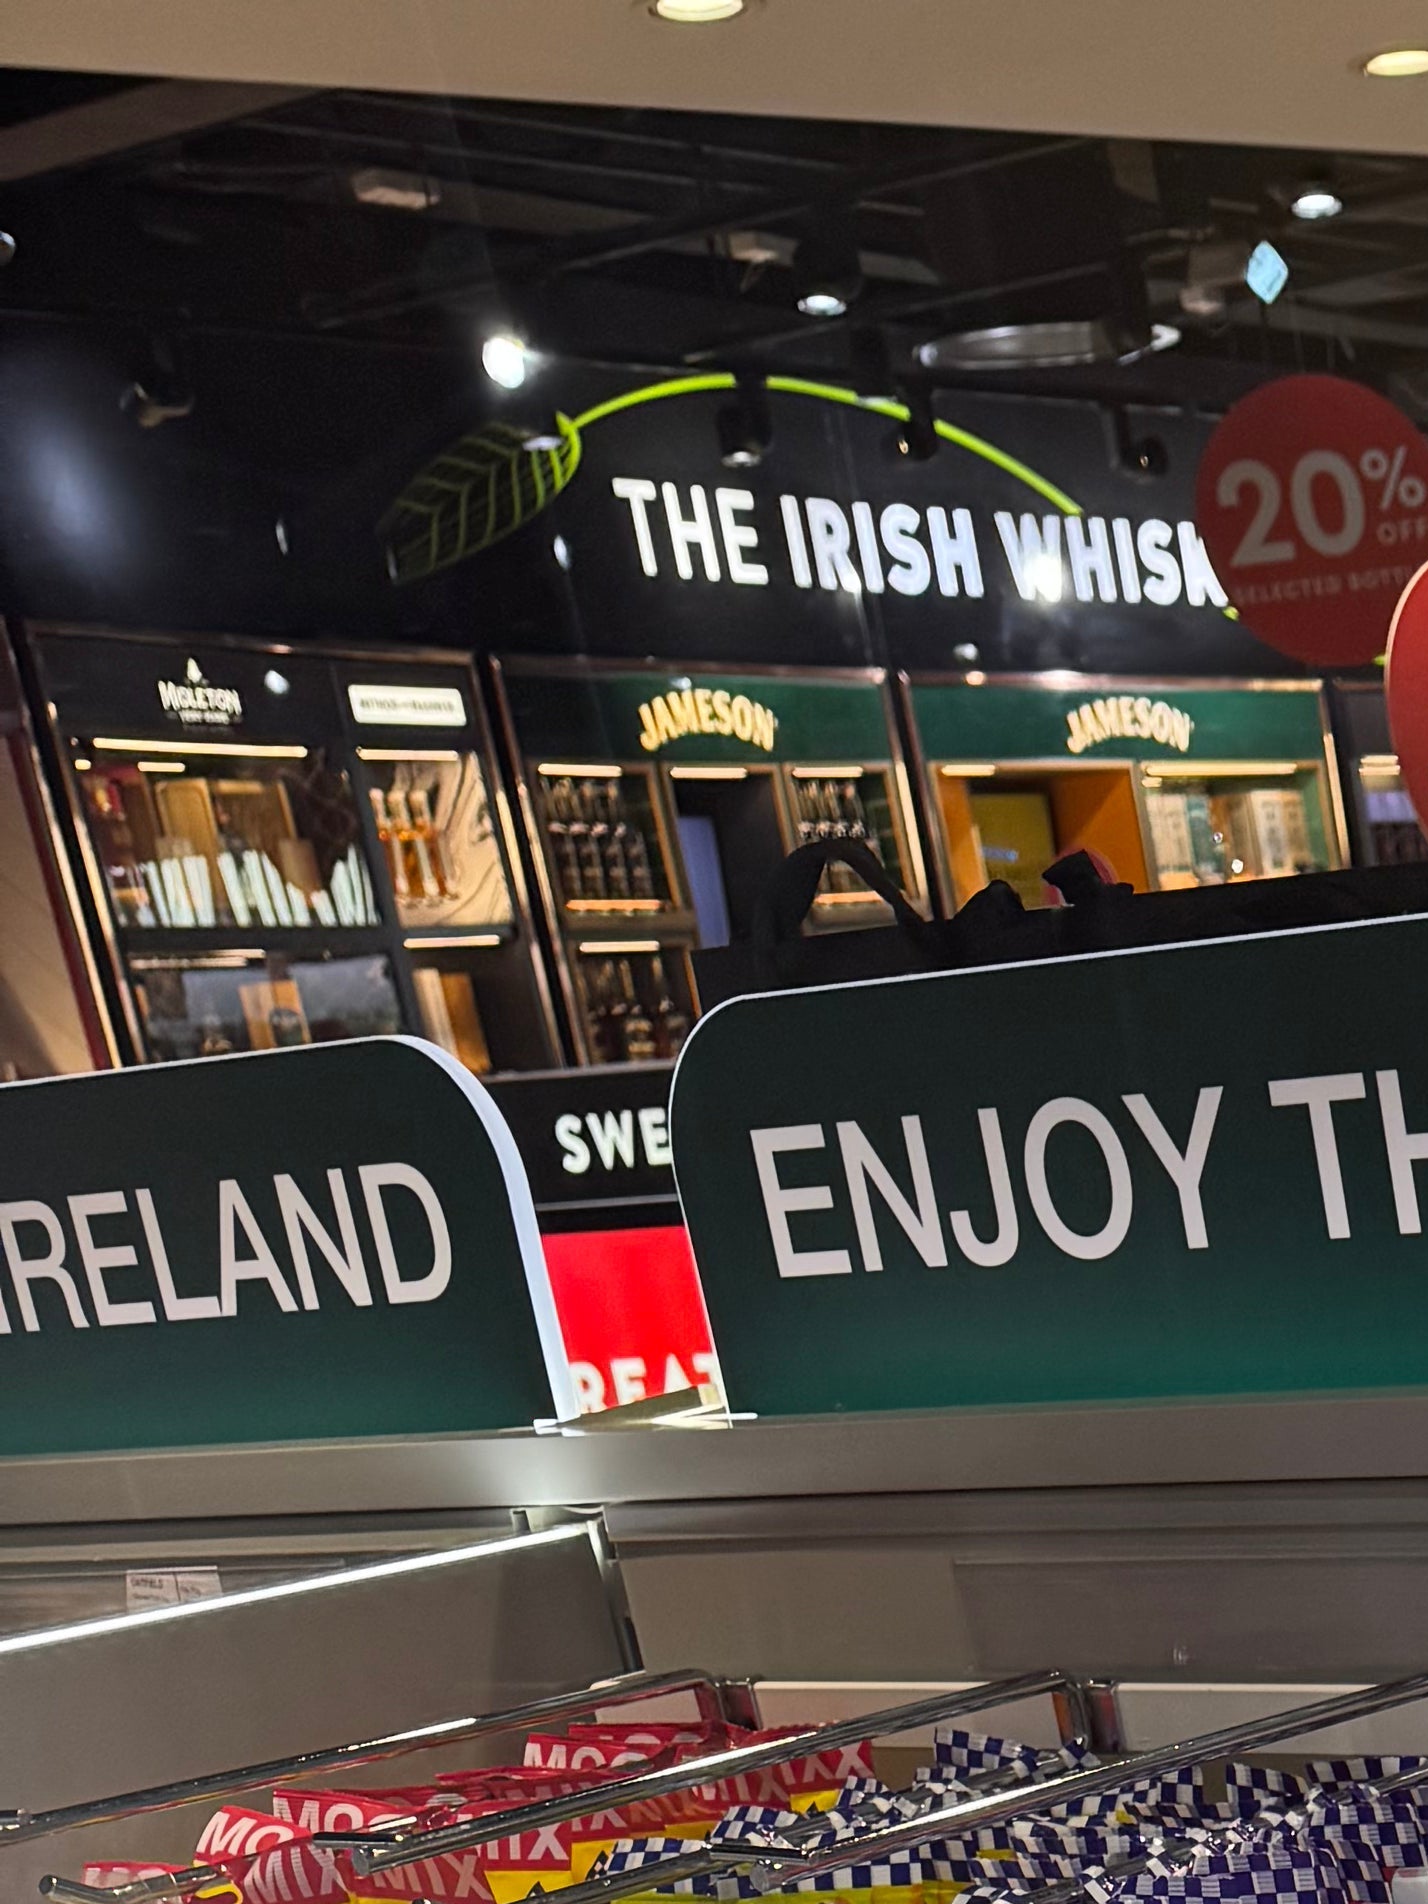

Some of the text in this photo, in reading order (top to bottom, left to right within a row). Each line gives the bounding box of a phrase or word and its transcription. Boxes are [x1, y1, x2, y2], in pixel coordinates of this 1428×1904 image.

[613, 477, 1228, 608] THE IRISH WHISK
[1218, 446, 1425, 567] 20%
[1378, 518, 1427, 545] OFF
[639, 689, 774, 753] JAMESON
[1067, 696, 1191, 754] JAMESON
[555, 1108, 671, 1174] SWE
[751, 1086, 1223, 1278] ENJOY
[0, 1161, 451, 1334] RELAND
